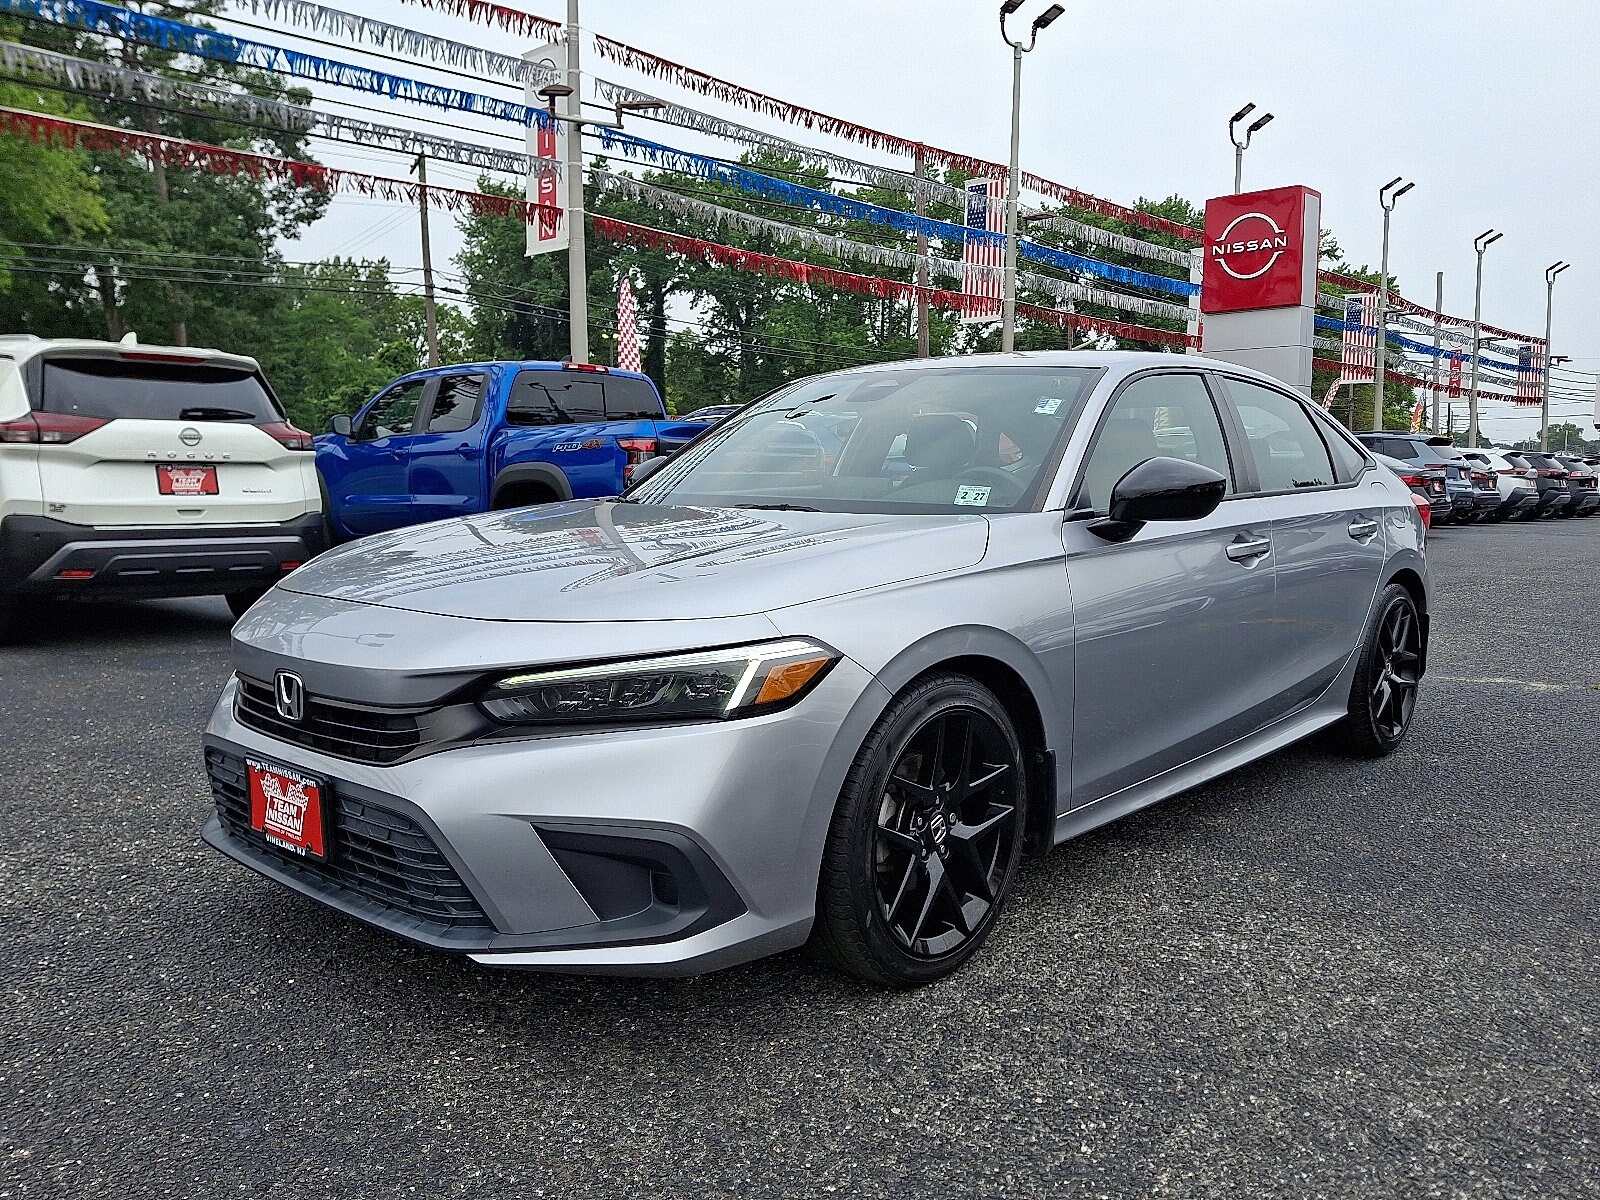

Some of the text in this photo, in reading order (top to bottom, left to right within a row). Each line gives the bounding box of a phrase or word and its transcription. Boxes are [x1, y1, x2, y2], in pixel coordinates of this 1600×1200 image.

[1212, 236, 1287, 256] NISSAN
[147, 450, 231, 459] ROGUE
[961, 491, 985, 501] 2 27
[273, 799, 298, 817] TEAM
[268, 809, 301, 831] NISSAN
